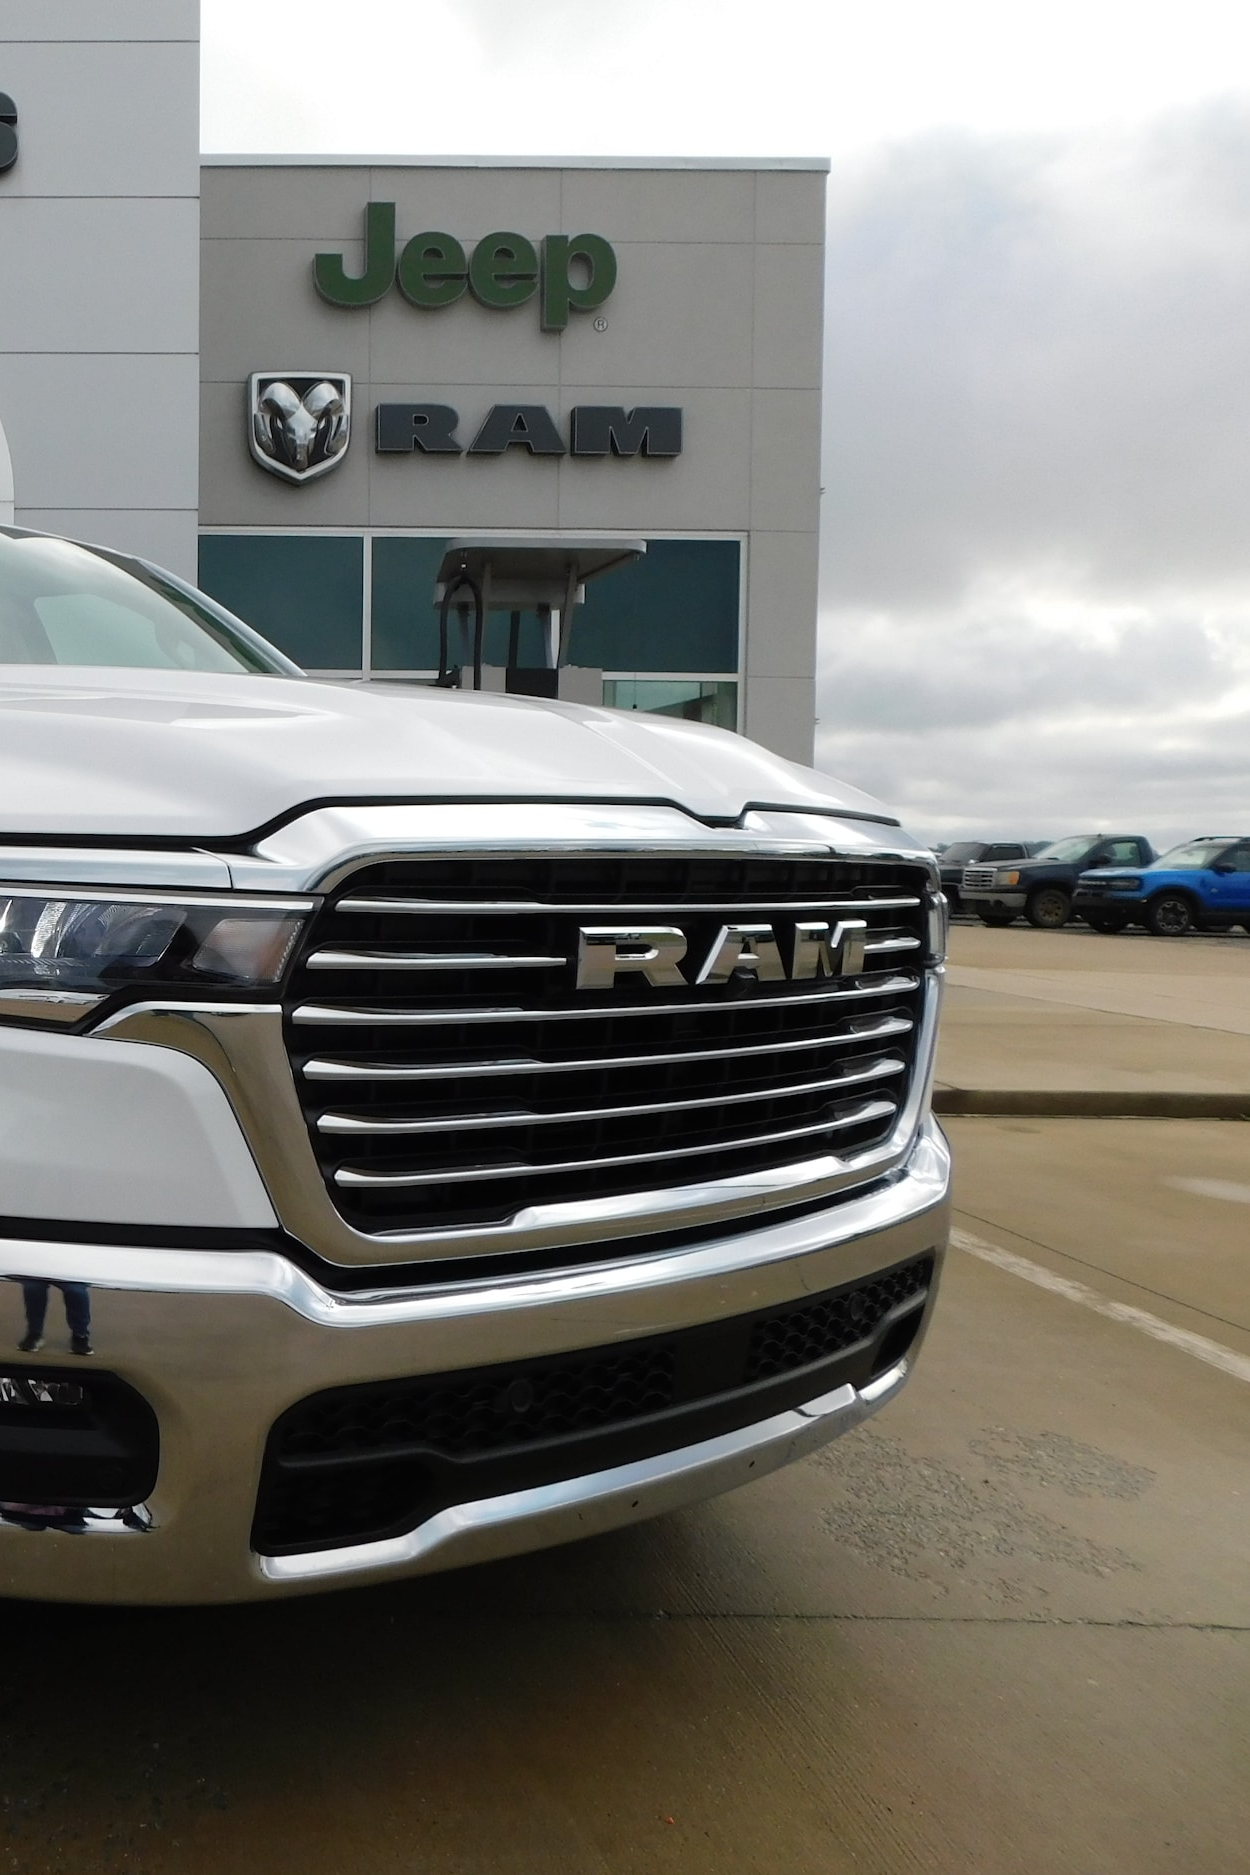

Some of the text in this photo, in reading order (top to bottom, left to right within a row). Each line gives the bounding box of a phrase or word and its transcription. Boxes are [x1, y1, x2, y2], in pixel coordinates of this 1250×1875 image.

[313, 202, 617, 332] Jeep
[376, 403, 683, 456] RAM
[576, 920, 867, 990] RAM
